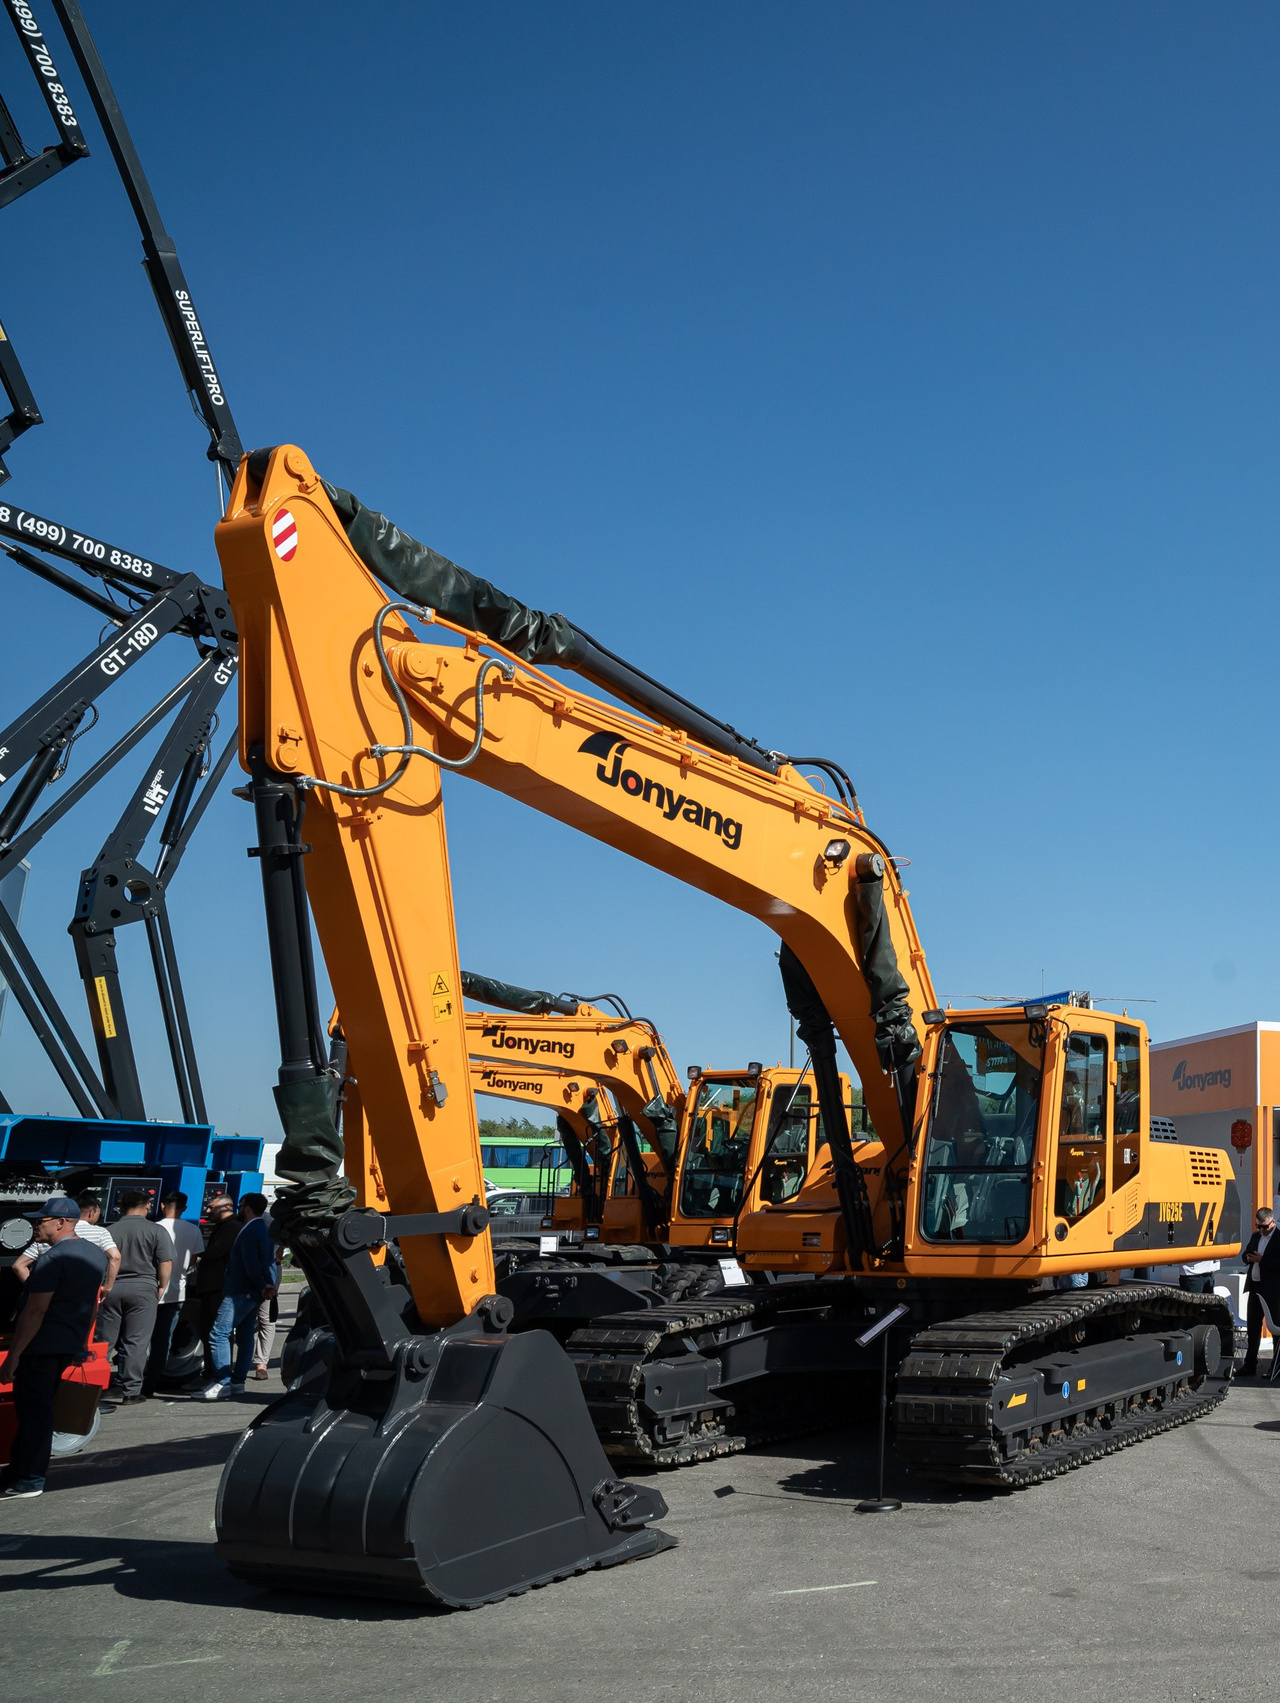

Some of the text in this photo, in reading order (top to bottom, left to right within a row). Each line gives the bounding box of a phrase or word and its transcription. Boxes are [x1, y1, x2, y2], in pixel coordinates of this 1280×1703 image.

[31, 44, 57, 77] 700
[47, 82, 77, 126] 8383
[175, 290, 224, 406] SUPERLIFT.PRO
[0, 507, 153, 578] 8 (499) 700 8383
[100, 622, 158, 676] GT-18D
[214, 656, 239, 685] GT-
[597, 743, 742, 850] Jonyang
[492, 1026, 575, 1058] Jonyang
[487, 1071, 543, 1094] Jonyang
[1178, 1064, 1232, 1091] Jonyang
[1159, 1202, 1183, 1222] JY625E
